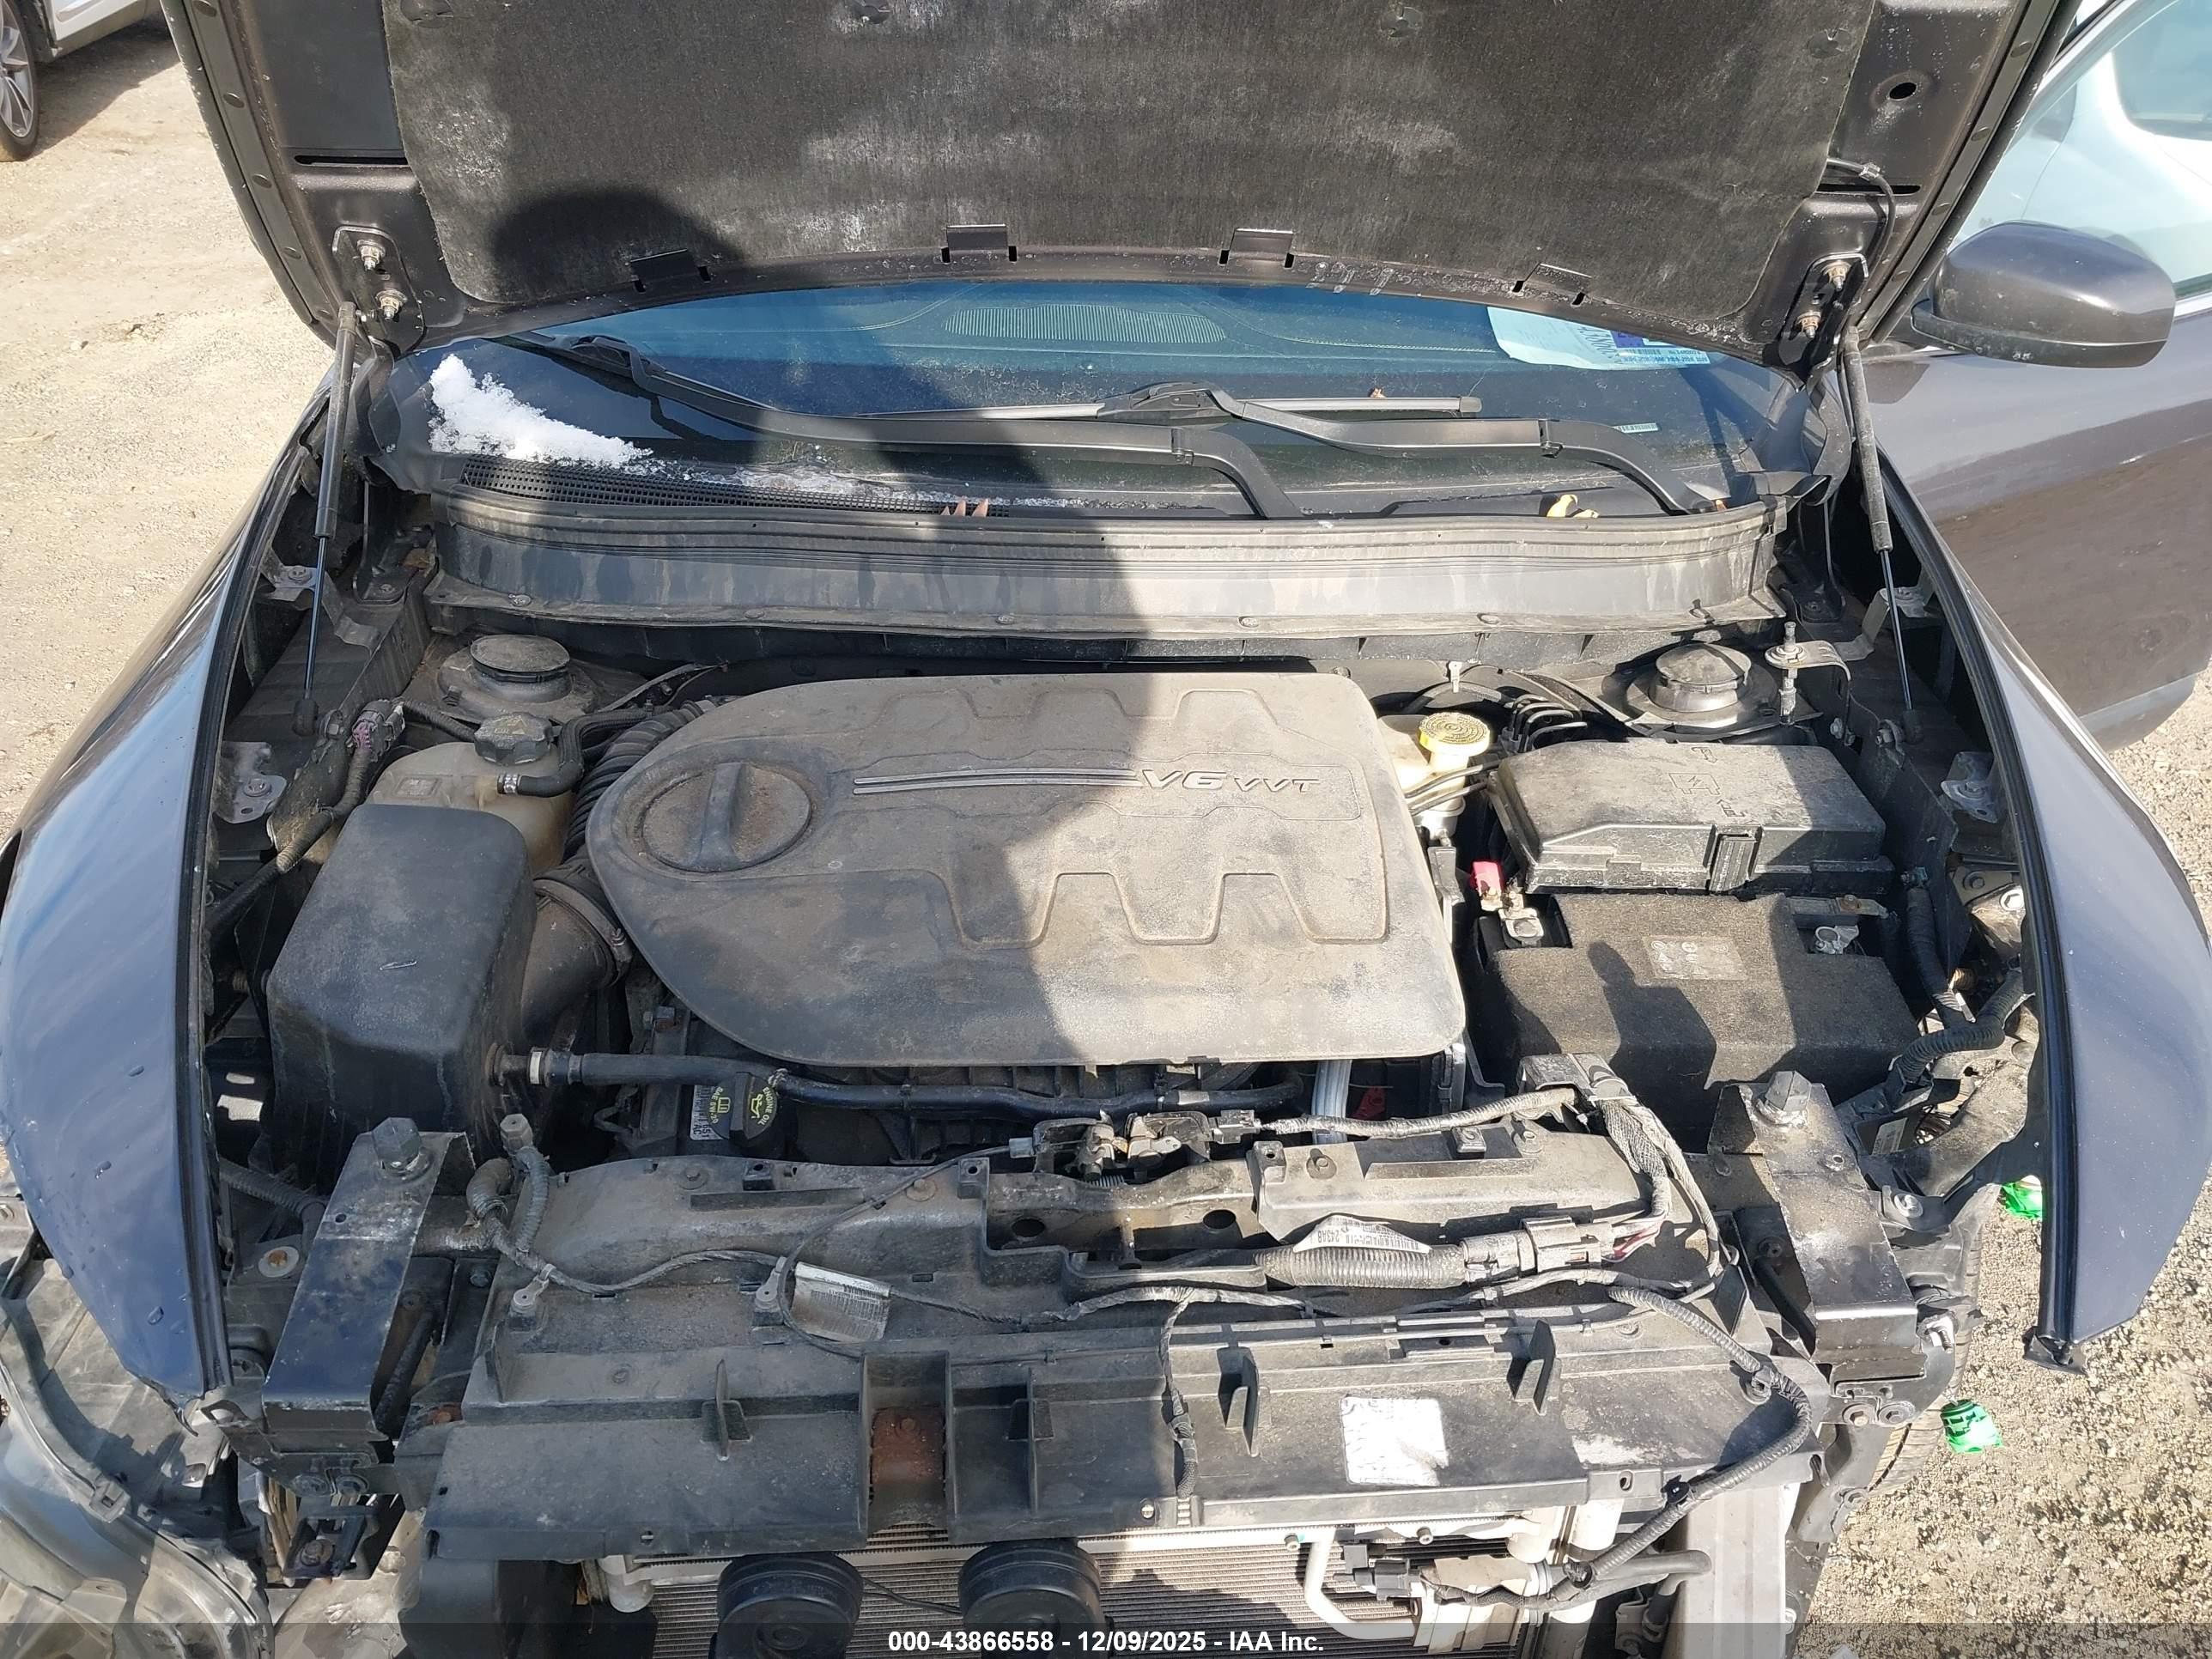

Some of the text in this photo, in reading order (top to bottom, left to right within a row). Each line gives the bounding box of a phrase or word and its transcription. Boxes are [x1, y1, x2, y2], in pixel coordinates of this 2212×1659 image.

[1142, 769, 1320, 792] V6 VVT
[711, 1086, 724, 1100] SAE
[757, 1086, 774, 1126] ENGINE OIL
